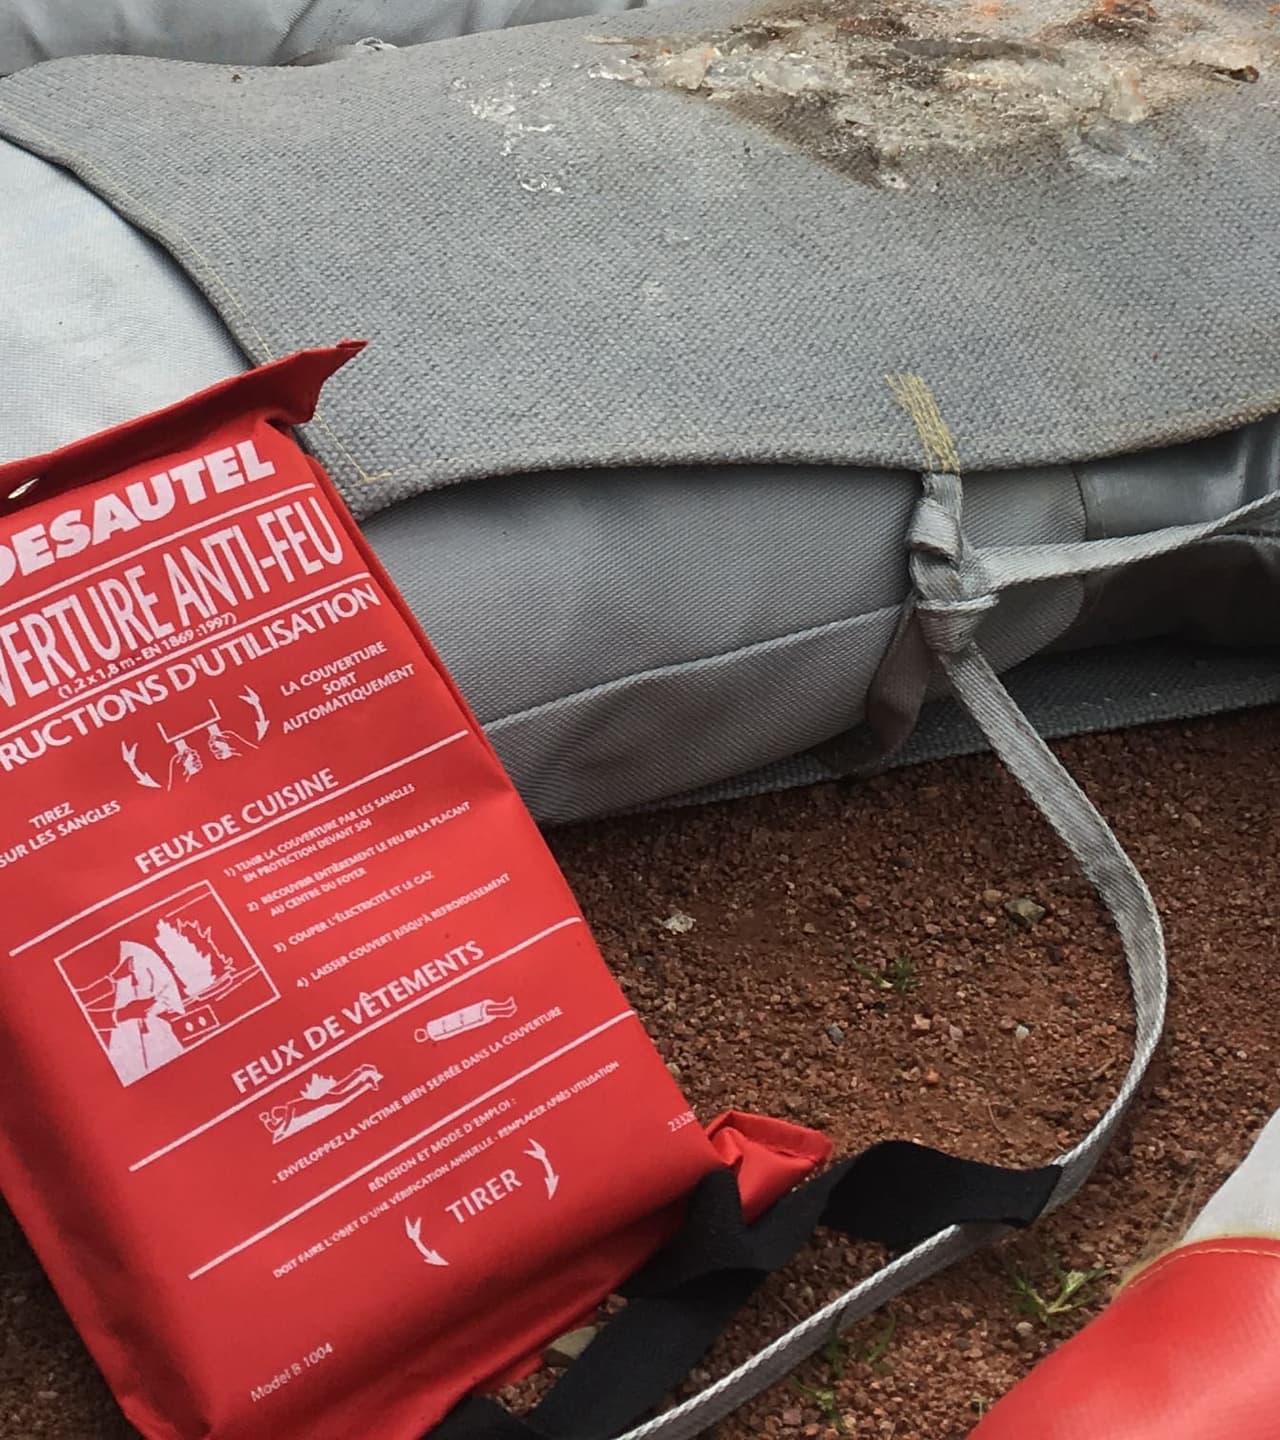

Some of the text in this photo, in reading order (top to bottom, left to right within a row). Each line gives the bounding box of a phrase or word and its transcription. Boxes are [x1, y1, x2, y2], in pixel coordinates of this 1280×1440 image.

[163, 497, 343, 632] ANTI-FEU
[58, 678, 87, 698] (1,2
[141, 644, 162, 659] EN
[161, 629, 194, 650] 1869
[166, 583, 381, 691] D'UTILISATION
[281, 641, 387, 696] LA COUVERTURE
[284, 664, 414, 734] AUTOMATIQUEMENT
[323, 672, 356, 695] SORT
[29, 802, 74, 828] TIREZ
[29, 830, 56, 849] LES
[57, 801, 120, 836] SANGLES
[135, 768, 338, 873] FEUX DE CUISINE
[263, 849, 278, 860] LA
[277, 820, 339, 853] COUVERTURE
[338, 811, 358, 825] PAR
[374, 784, 414, 808] SANGLES
[271, 905, 285, 916] AU
[349, 933, 392, 959] COUVERT
[232, 941, 483, 1093] FEUX DE VÊTEMENTS
[277, 1007, 562, 1181] ENVELOPPEZ LA VICTIME BIEN SERRÉE DANS LA COUVERTURE
[368, 1157, 416, 1192] RÉVISION
[417, 1148, 430, 1161] ET
[430, 1129, 464, 1153] MODE
[445, 1169, 522, 1222] TIRER
[251, 1369, 291, 1401] Model
[304, 1343, 333, 1367] 1004
